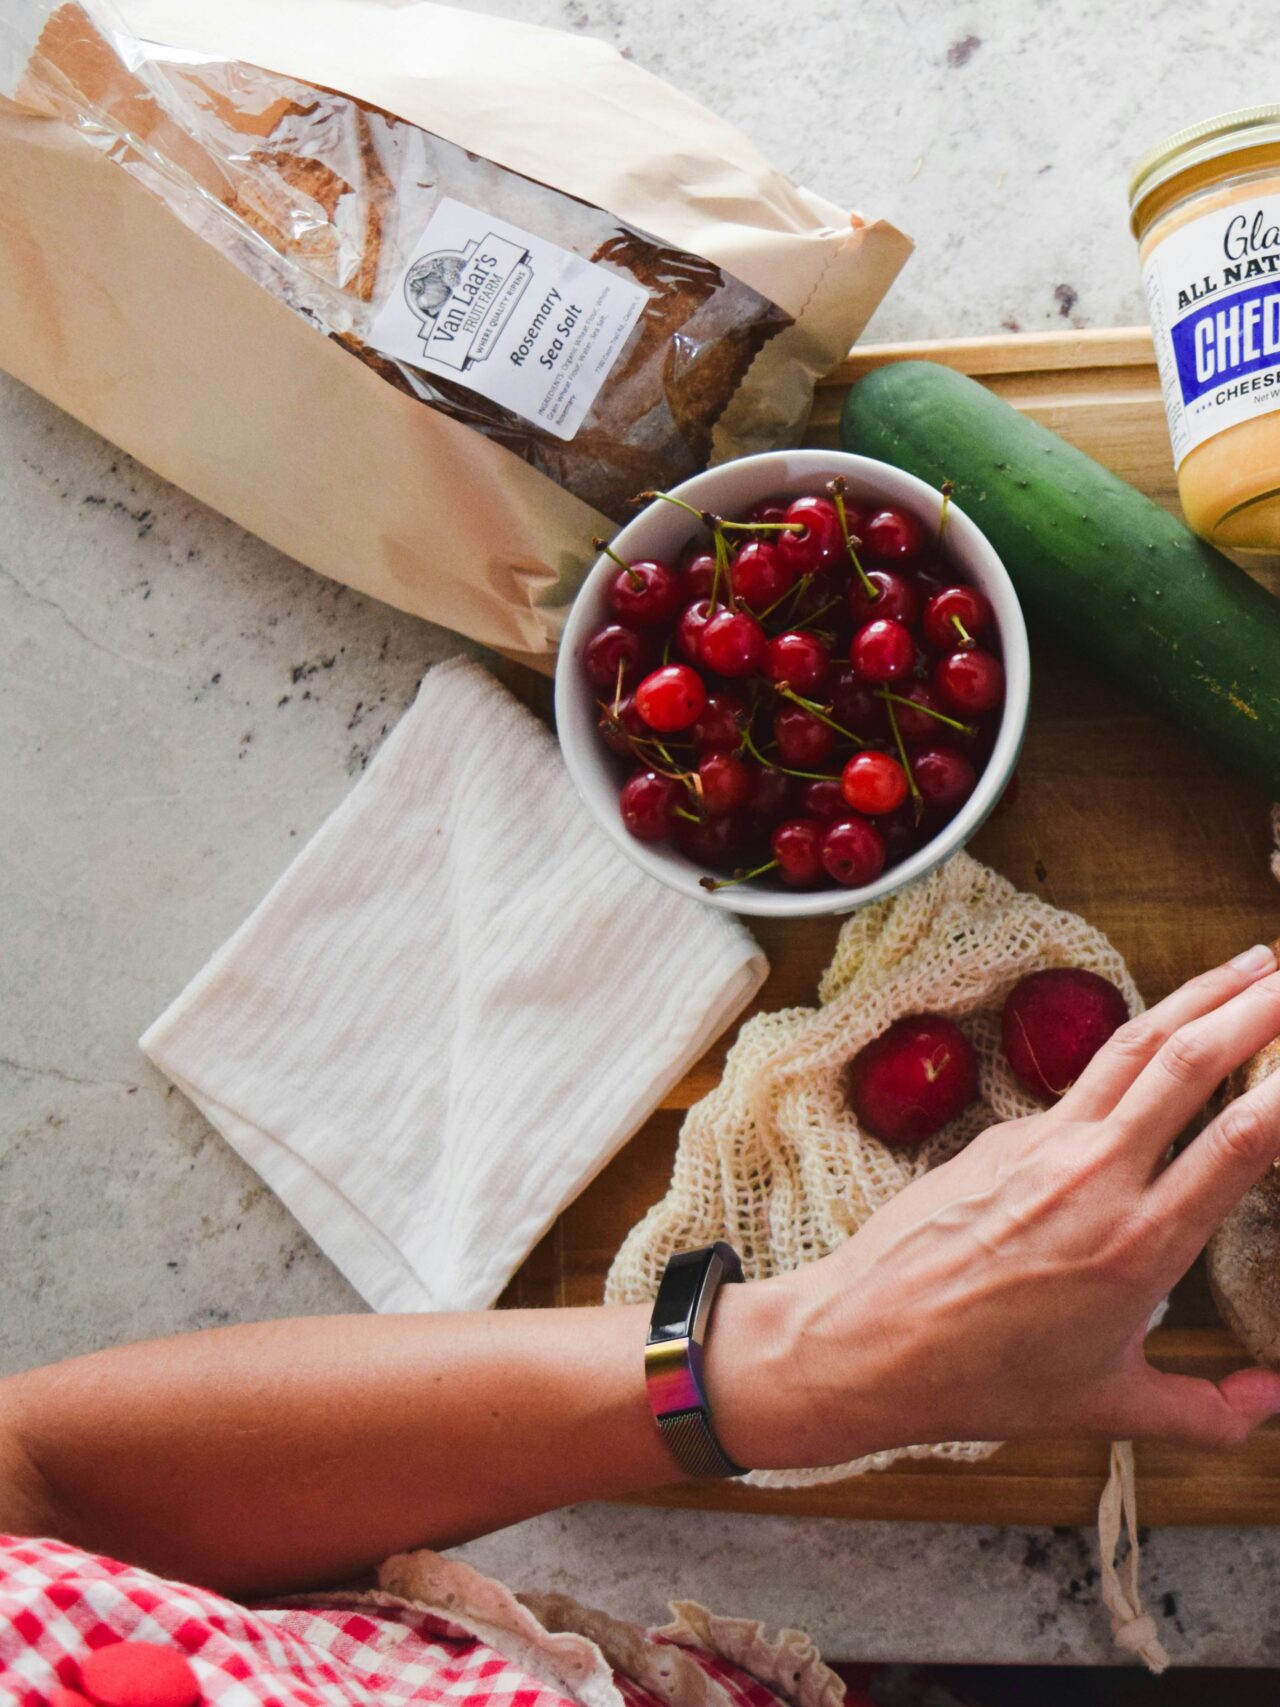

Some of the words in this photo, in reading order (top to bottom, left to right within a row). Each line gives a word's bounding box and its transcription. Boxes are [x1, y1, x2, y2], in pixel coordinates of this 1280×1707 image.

[433, 308, 466, 341] Van
[451, 254, 497, 307] Laar's
[462, 302, 485, 334] FRUIT
[478, 273, 503, 304] FARM
[476, 328, 493, 353] WHERE
[489, 296, 509, 327] QUALITY
[506, 272, 525, 296] RIPENS
[1176, 274, 1218, 311] ALL
[510, 288, 562, 367] Rosemary
[539, 338, 564, 370] Sea
[556, 305, 582, 338] Salt
[1253, 393, 1269, 404] Net
